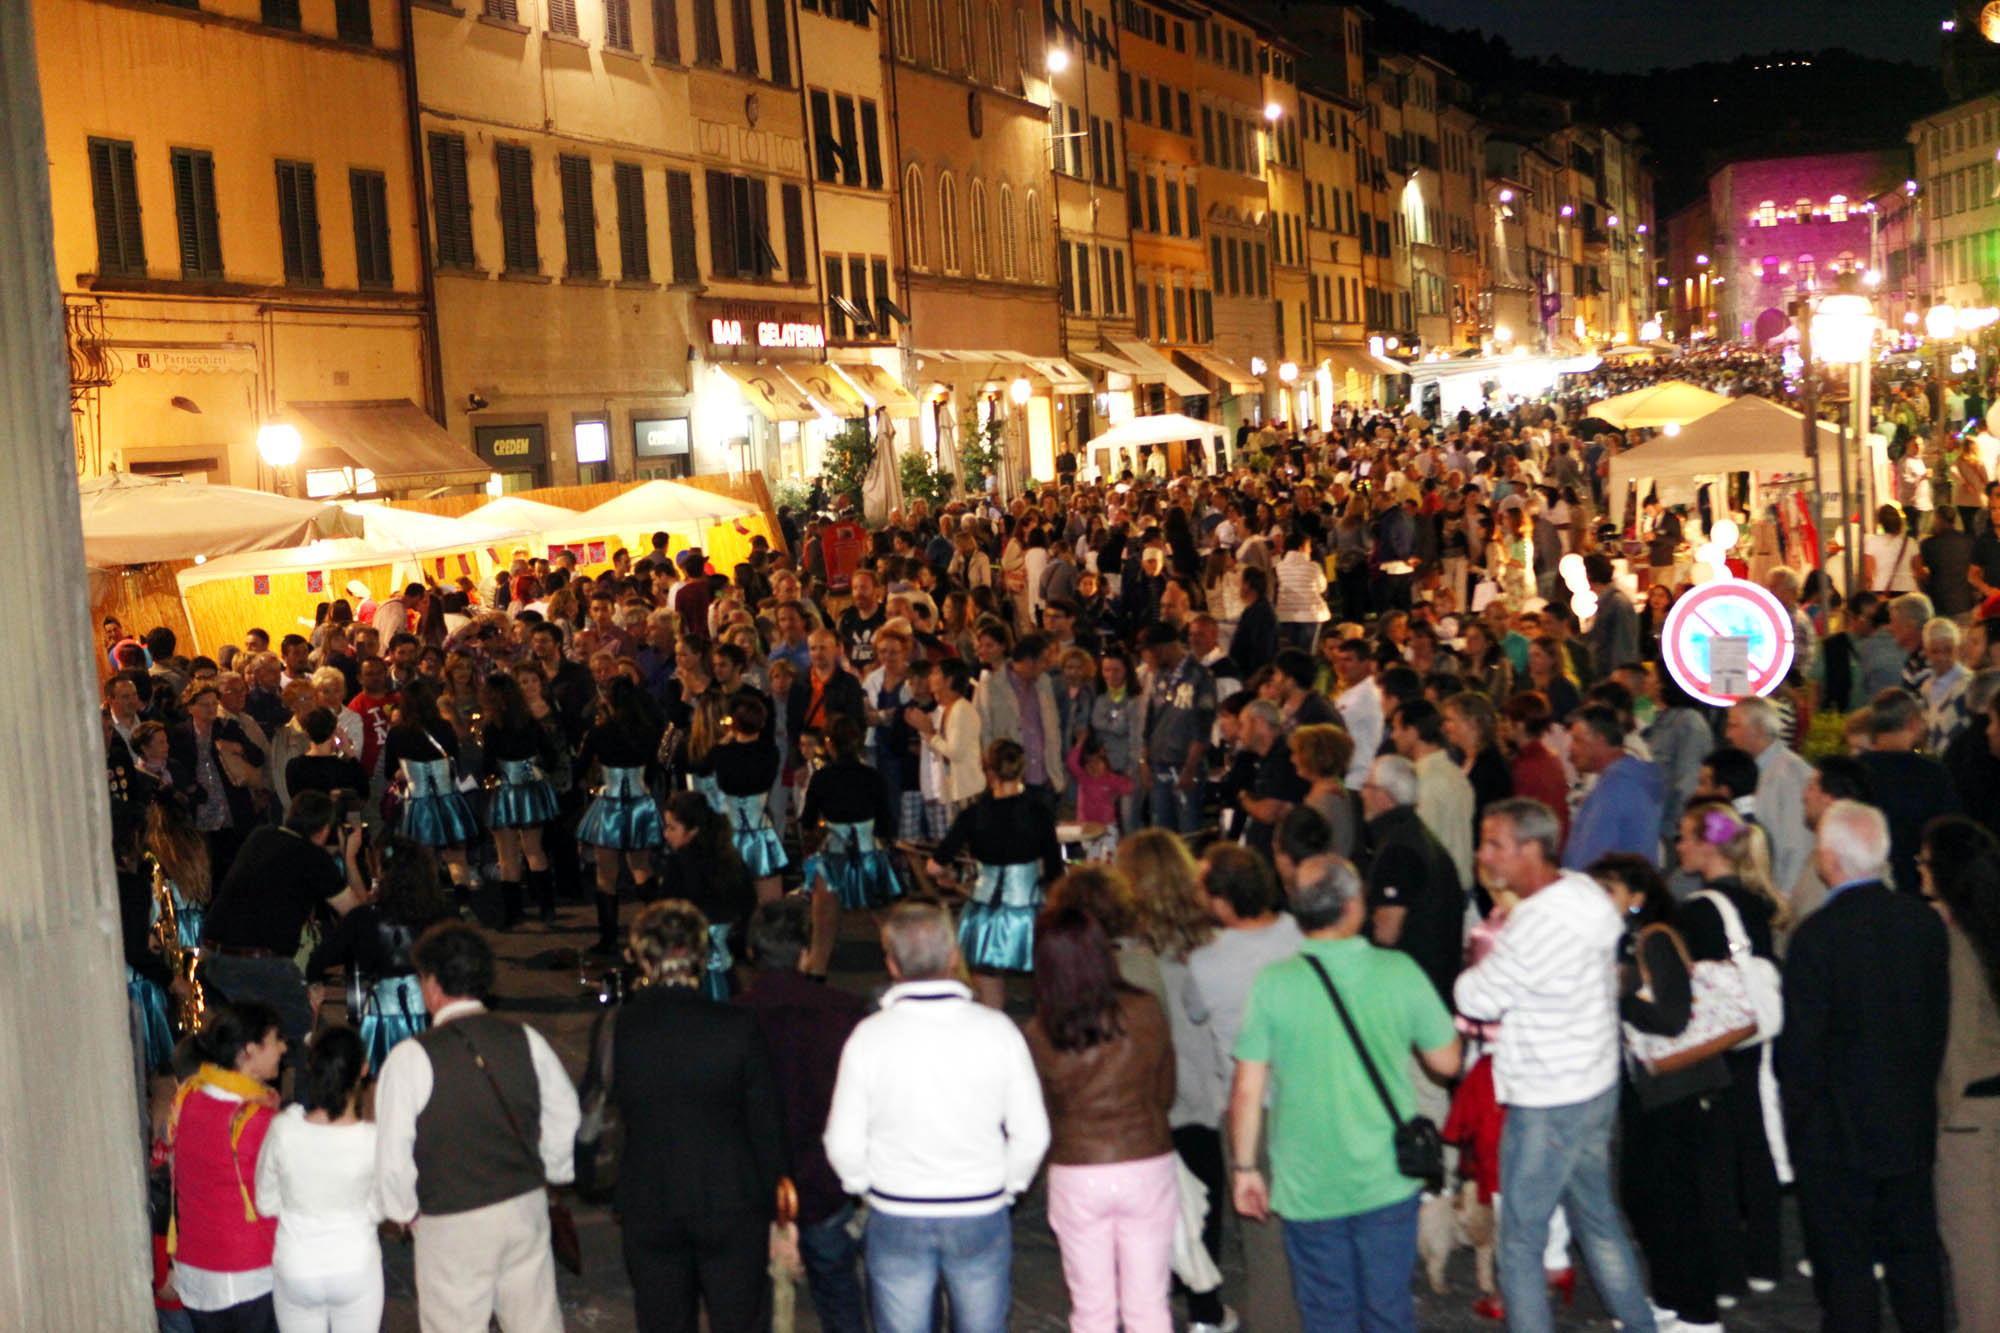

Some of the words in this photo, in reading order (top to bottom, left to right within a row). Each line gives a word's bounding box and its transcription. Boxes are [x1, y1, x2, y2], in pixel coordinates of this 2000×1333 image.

[712, 319, 742, 345] BAR
[758, 321, 825, 347] GELATERIA
[493, 438, 529, 456] CREDEM
